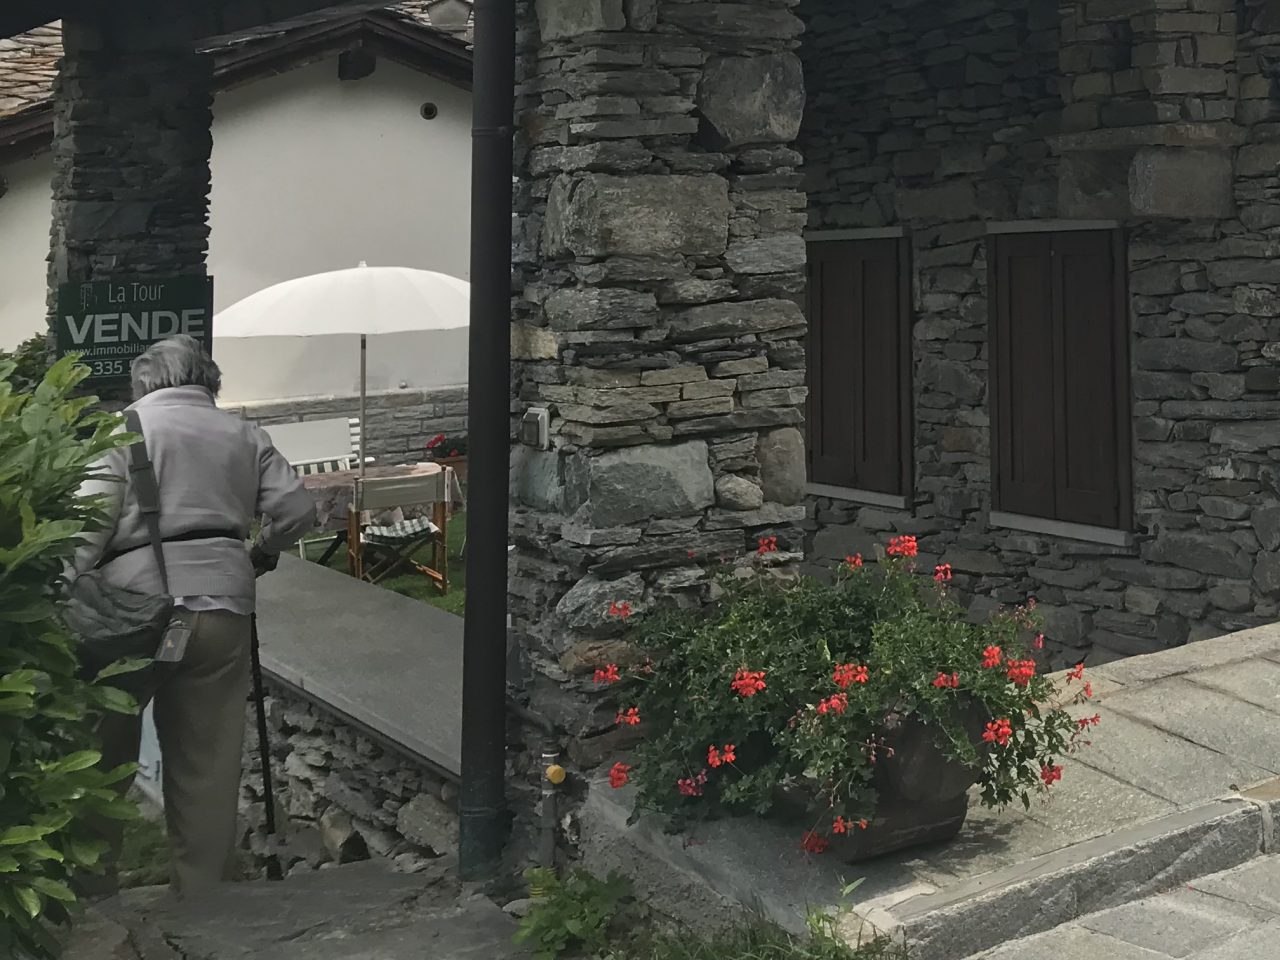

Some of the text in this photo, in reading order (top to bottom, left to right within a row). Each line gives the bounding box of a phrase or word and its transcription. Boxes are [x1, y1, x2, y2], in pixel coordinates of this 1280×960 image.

[108, 282, 165, 303] La Tour
[65, 308, 206, 345] VENDE
[93, 360, 123, 376] 335
